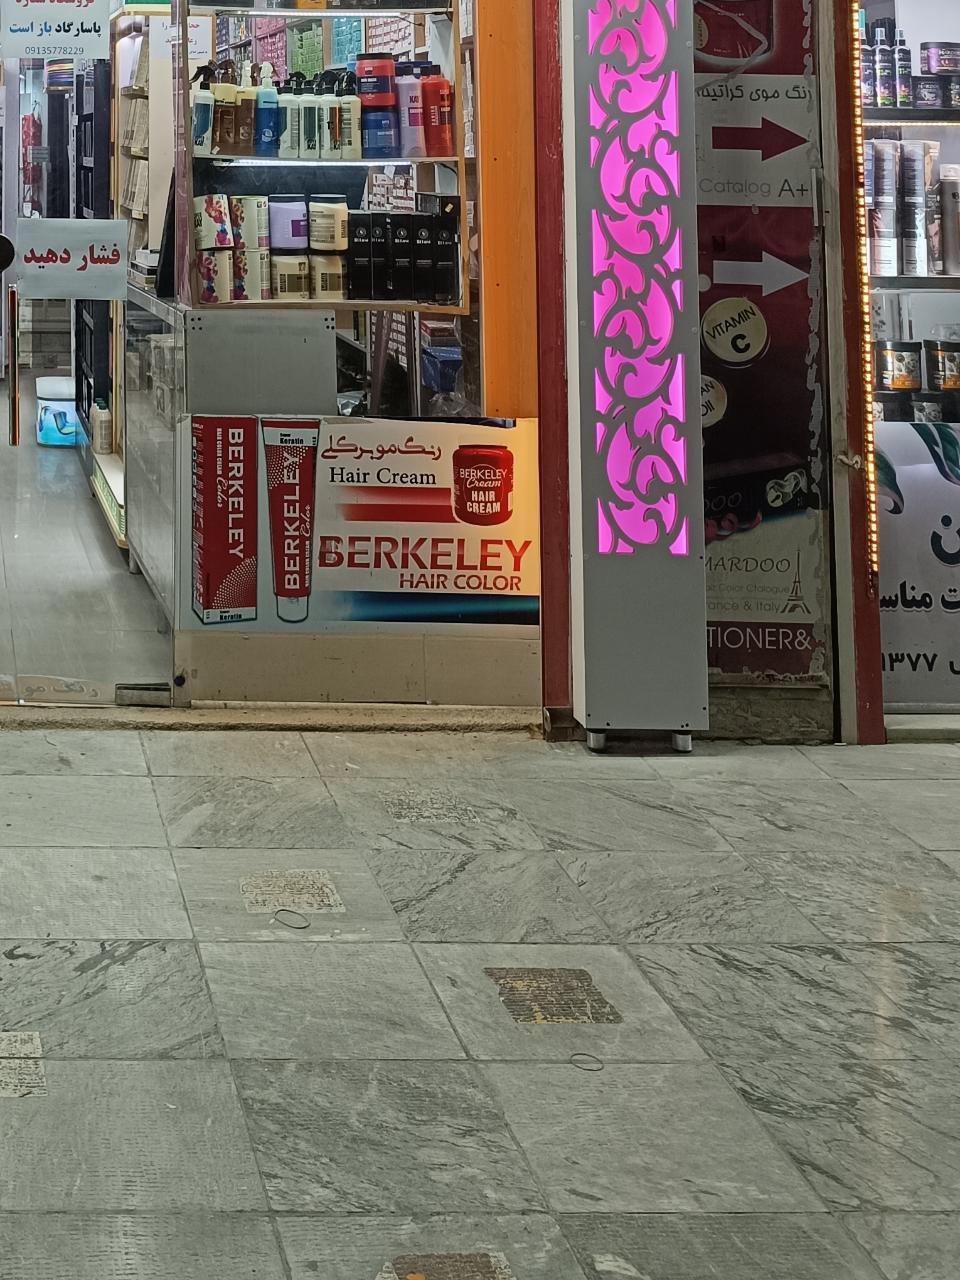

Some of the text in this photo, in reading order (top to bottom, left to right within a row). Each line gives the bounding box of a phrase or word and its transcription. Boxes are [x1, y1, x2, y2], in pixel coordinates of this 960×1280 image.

[8, 20, 102, 40] پاسارگاد باز است
[25, 46, 84, 56] 09135778229
[749, 90, 780, 104] موی
[698, 177, 809, 198] Catalog A+
[23, 242, 121, 271] فشار دهید
[704, 306, 757, 340] VITAMIN
[730, 333, 751, 354] C
[279, 437, 304, 445] Keratin
[329, 466, 437, 486] Hair Cream
[460, 468, 508, 480] BERKELEY
[466, 477, 501, 489] Cream
[228, 428, 244, 559] BERKELEY
[471, 490, 496, 502] HAIR
[466, 501, 501, 514] CREAM
[284, 450, 300, 590] BERKELEY
[318, 535, 533, 572] BERKELEY
[399, 573, 522, 591] HAIR COLOR
[743, 600, 753, 611] &
[755, 599, 781, 614] Italy
[219, 613, 243, 621] Keratin
